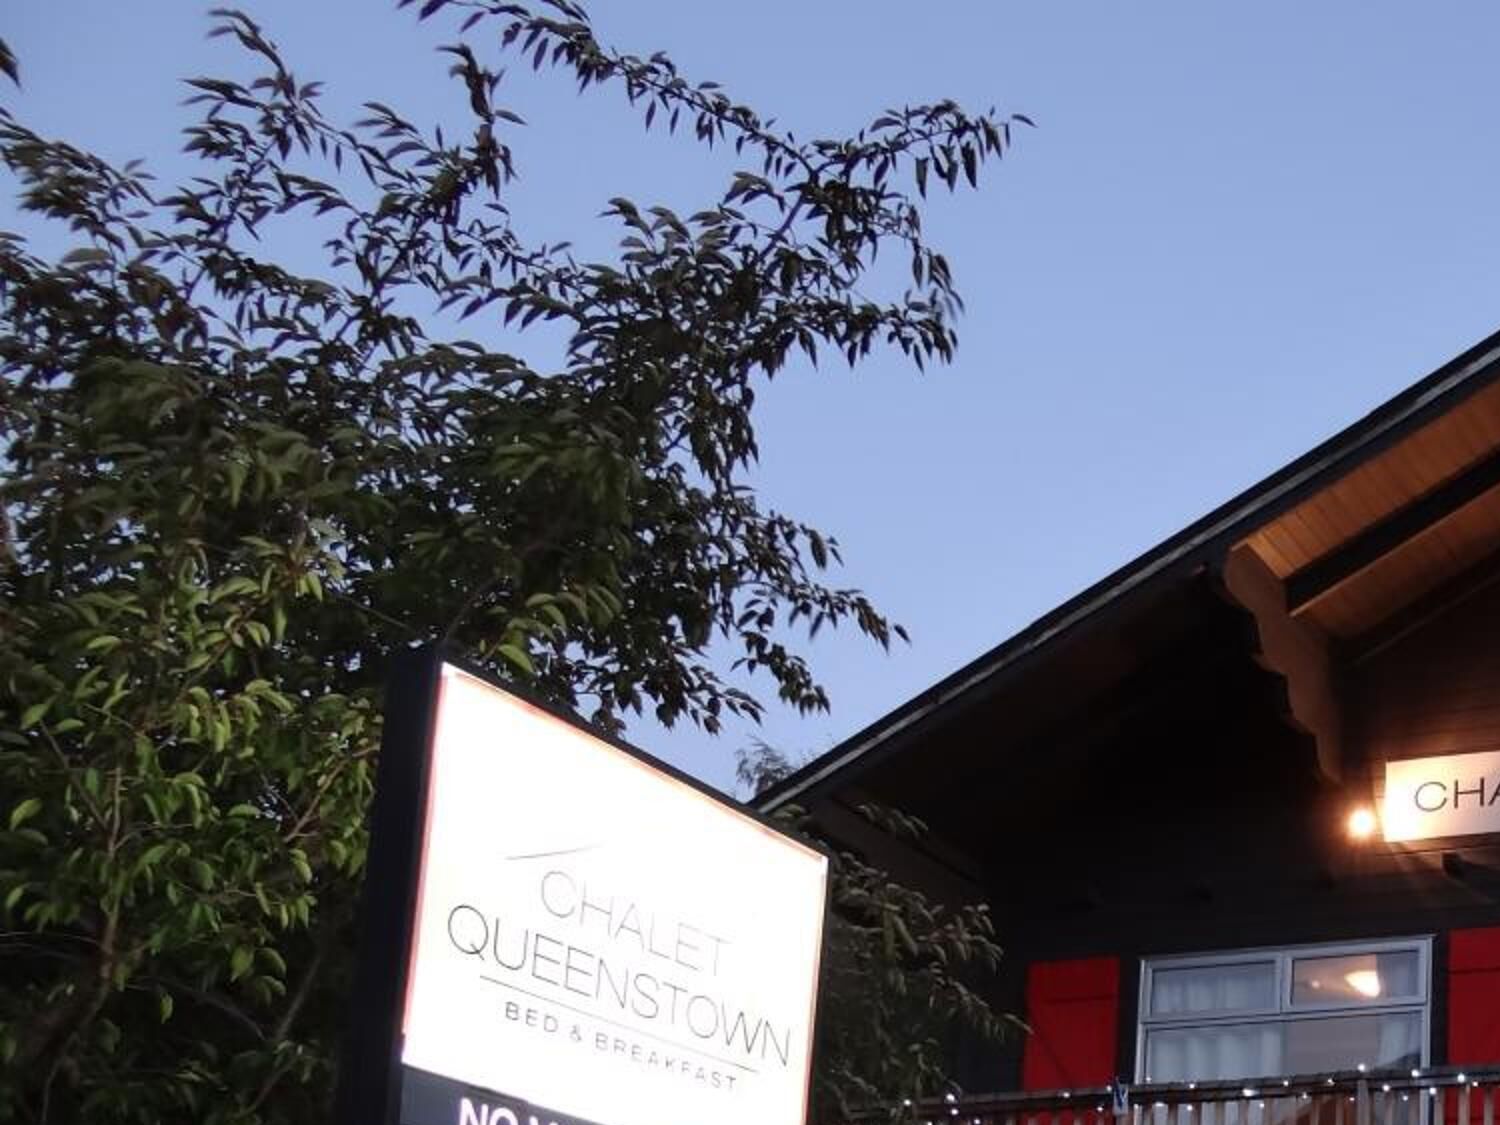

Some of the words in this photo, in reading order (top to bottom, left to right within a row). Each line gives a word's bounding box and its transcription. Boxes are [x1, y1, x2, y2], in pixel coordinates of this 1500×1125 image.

[541, 870, 734, 977] CHALET
[448, 904, 792, 1068] QUEENSTOWN
[505, 1001, 558, 1034] BED
[569, 1023, 583, 1043] &
[594, 1032, 738, 1090] BREAKFAST
